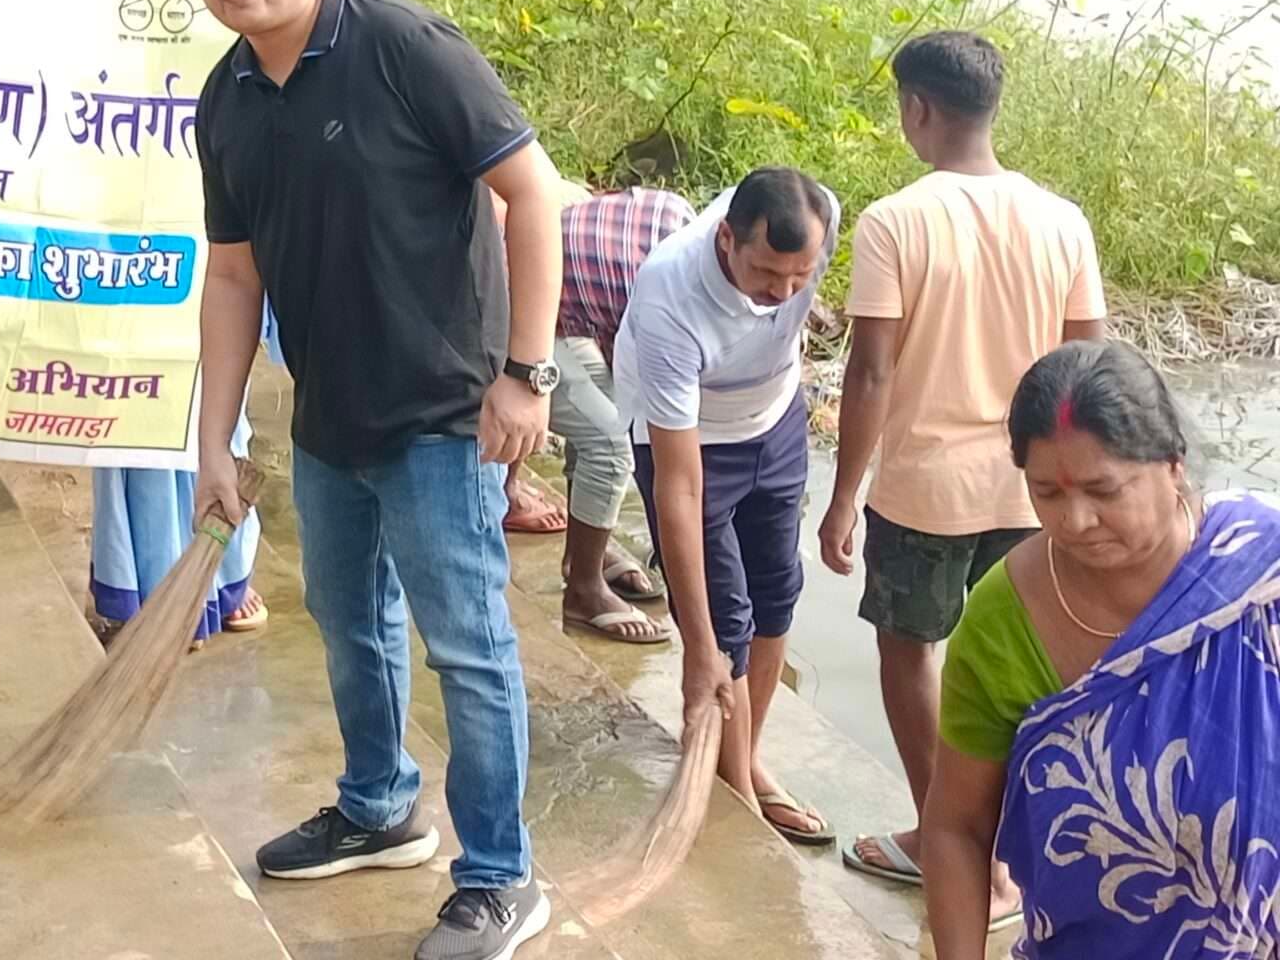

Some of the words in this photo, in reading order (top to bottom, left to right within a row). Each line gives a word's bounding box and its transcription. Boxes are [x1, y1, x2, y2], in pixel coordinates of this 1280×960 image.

[40, 236, 184, 302] शुभारंभ
[5, 359, 164, 401] अभियान
[4, 409, 119, 446] जामताड़ा
